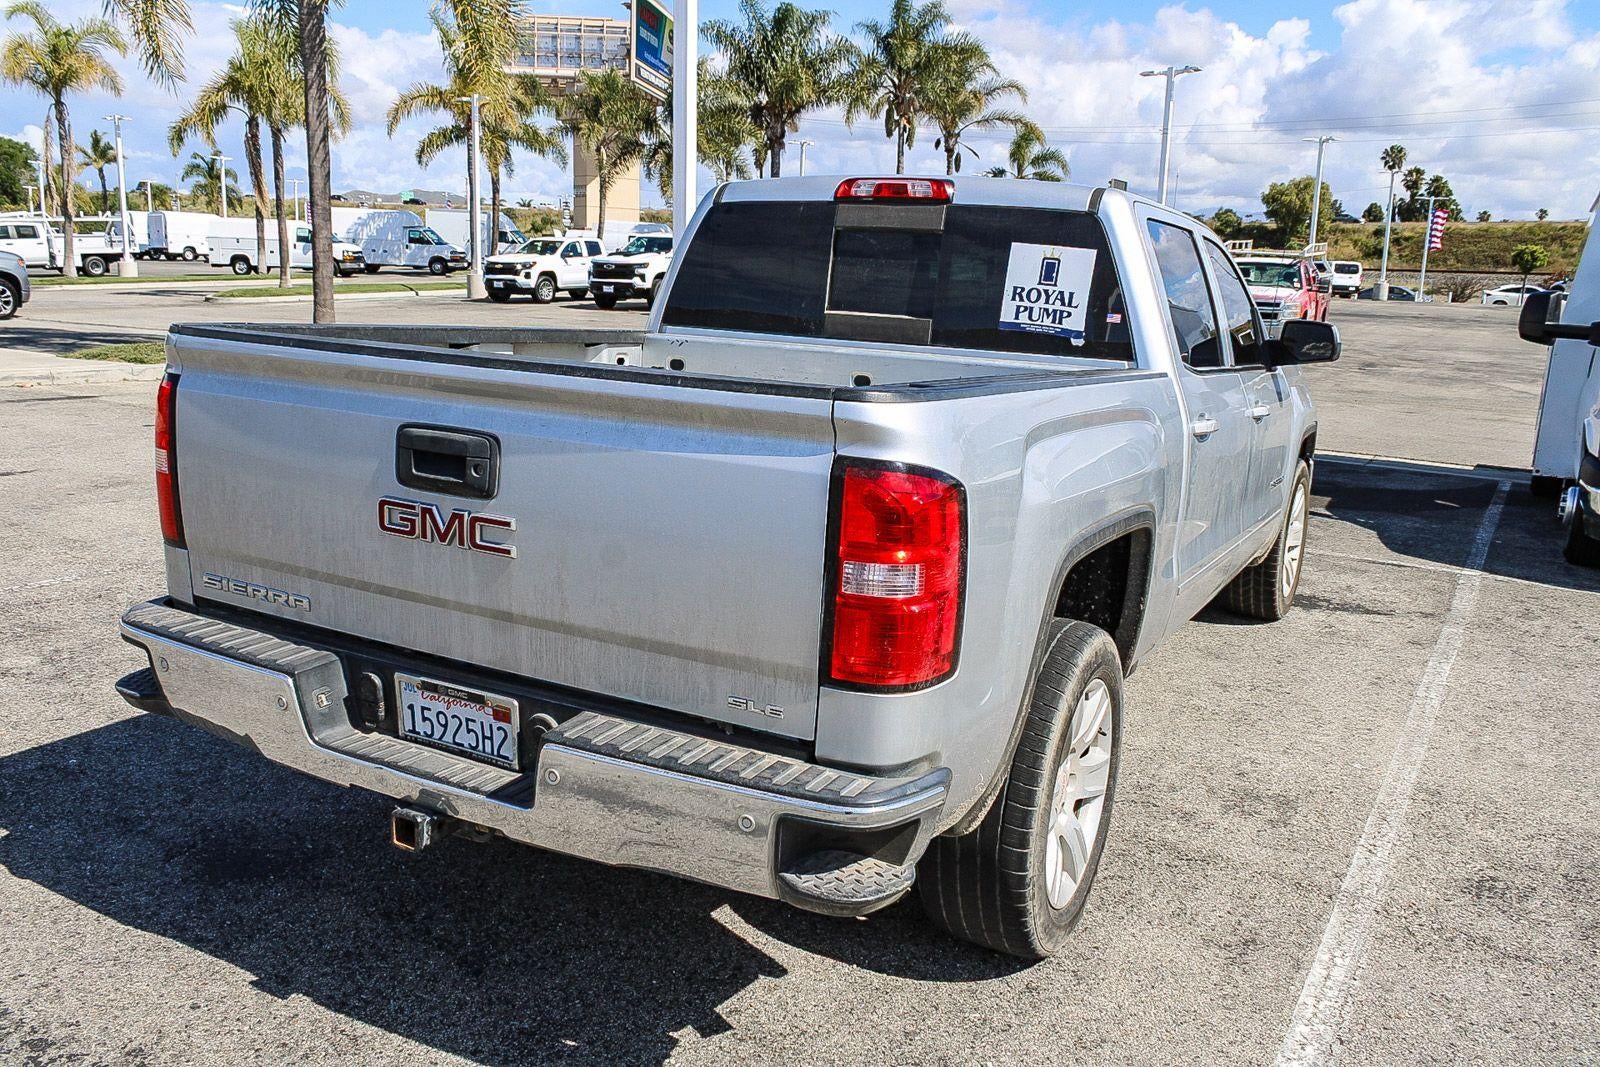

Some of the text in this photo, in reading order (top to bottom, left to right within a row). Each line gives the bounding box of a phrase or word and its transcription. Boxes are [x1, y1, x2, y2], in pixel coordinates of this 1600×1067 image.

[1010, 285, 1080, 309] ROYAL
[1013, 304, 1073, 326] PUMP
[377, 494, 517, 559] GMC
[203, 572, 312, 613] SIERRA
[407, 703, 510, 760] 15925H2
